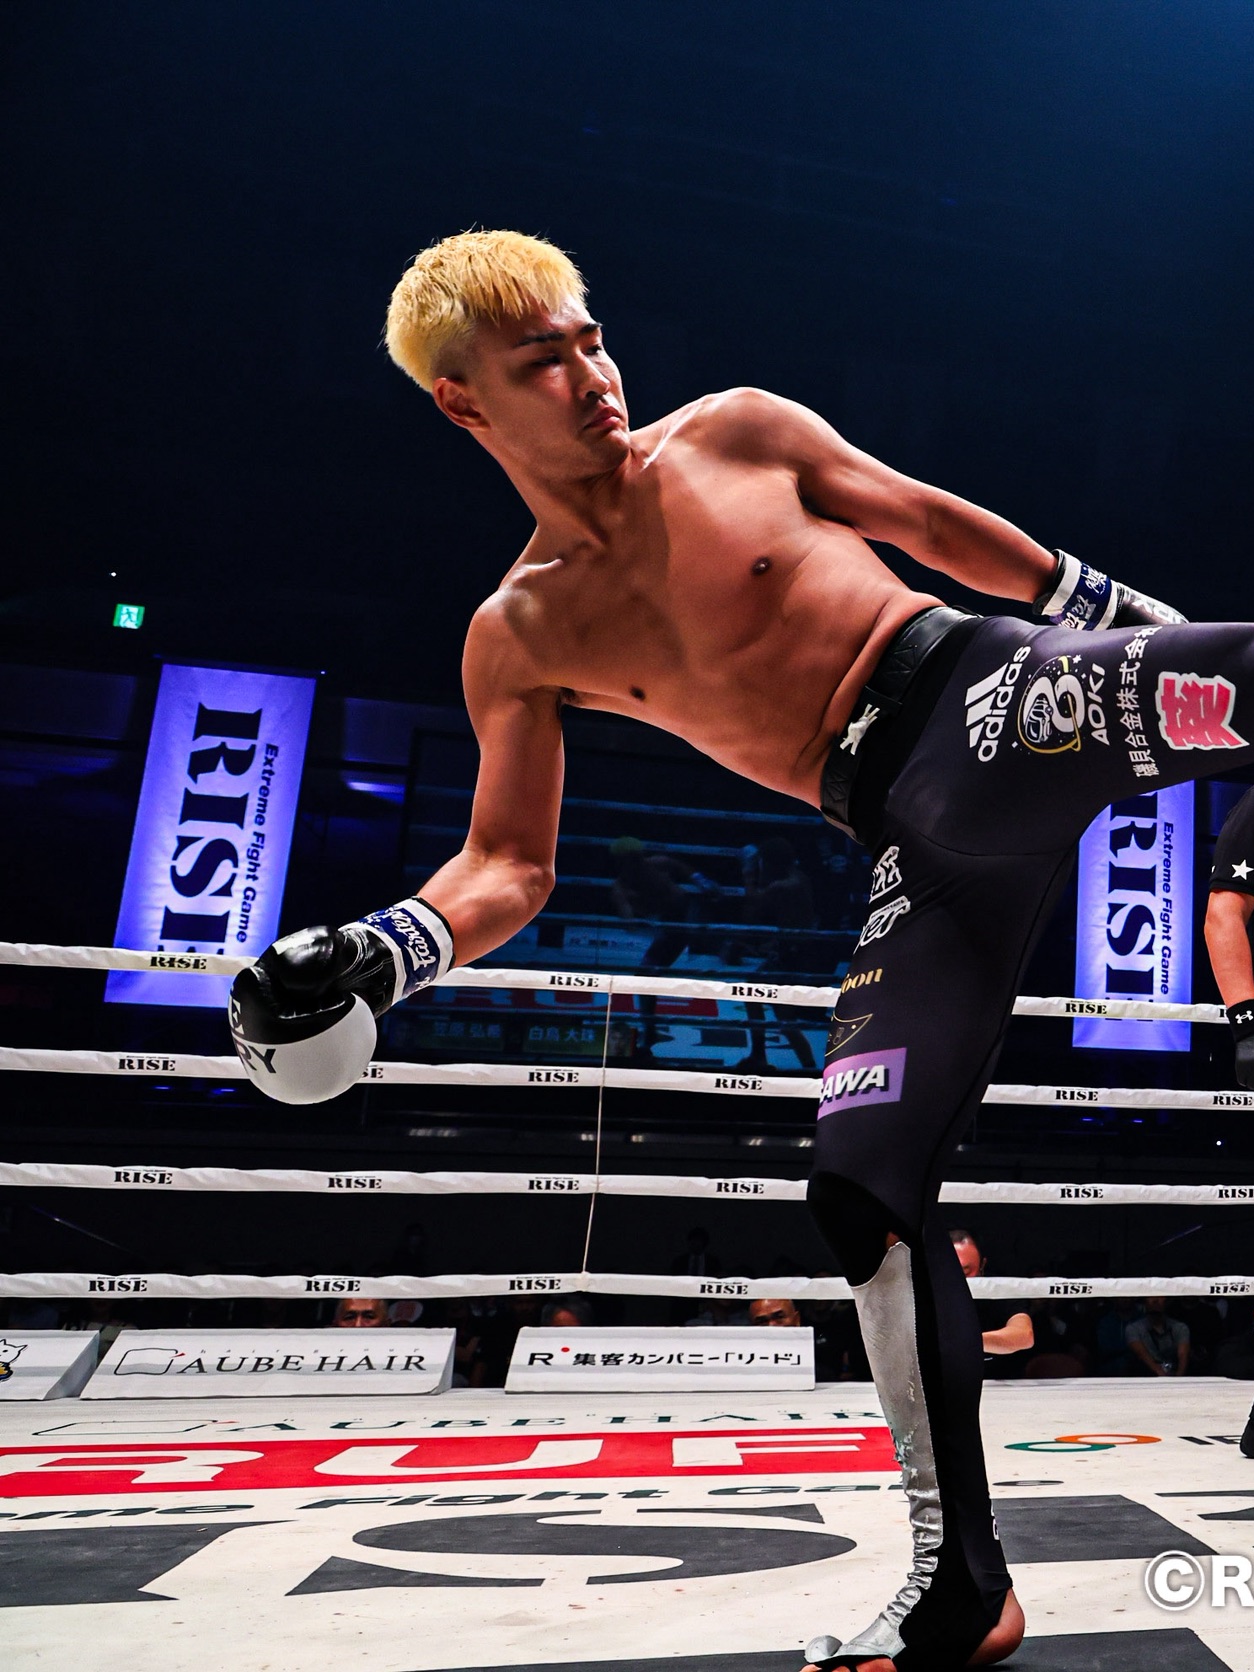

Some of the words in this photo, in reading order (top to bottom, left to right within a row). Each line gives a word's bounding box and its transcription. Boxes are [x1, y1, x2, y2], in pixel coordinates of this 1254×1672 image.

[977, 645, 1032, 763] adidas
[1087, 663, 1110, 746] AOKI
[253, 743, 279, 826] Extreme
[244, 828, 266, 887] Fight
[1162, 822, 1174, 892] Extreme
[236, 889, 258, 943] Game
[1160, 895, 1173, 942] Fight
[149, 955, 207, 970] RISE
[1160, 946, 1172, 995] Game
[550, 975, 599, 988] RISE
[731, 986, 778, 999] RISE
[1065, 1002, 1107, 1015] RISE
[118, 1058, 176, 1072] RISE
[361, 1066, 384, 1079] SE
[528, 1070, 580, 1084] RISE
[714, 1077, 762, 1091] RISE
[819, 1065, 885, 1103] AWA
[1055, 1090, 1099, 1102] RISE
[1212, 1095, 1253, 1107] RISE
[114, 1170, 173, 1185] RISE
[328, 1176, 383, 1190] RISE
[528, 1179, 580, 1192] RISE
[716, 1182, 765, 1195] RISE
[1060, 1187, 1104, 1199] RISE
[88, 1279, 148, 1293] RISE
[305, 1279, 361, 1293] RISE
[509, 1278, 561, 1292] RISE
[700, 1282, 748, 1296] RISE
[1049, 1284, 1093, 1295] RISE
[1209, 1283, 1250, 1295] RISE
[177, 1355, 305, 1373] AUBE
[313, 1355, 427, 1372] HAIR
[528, 1353, 554, 1366] R
[573, 1352, 802, 1366] 集客カンパニー「リード」
[217, 1415, 566, 1431] AUBE
[608, 1410, 886, 1425] HAIR
[296, 1489, 669, 1511] Fight
